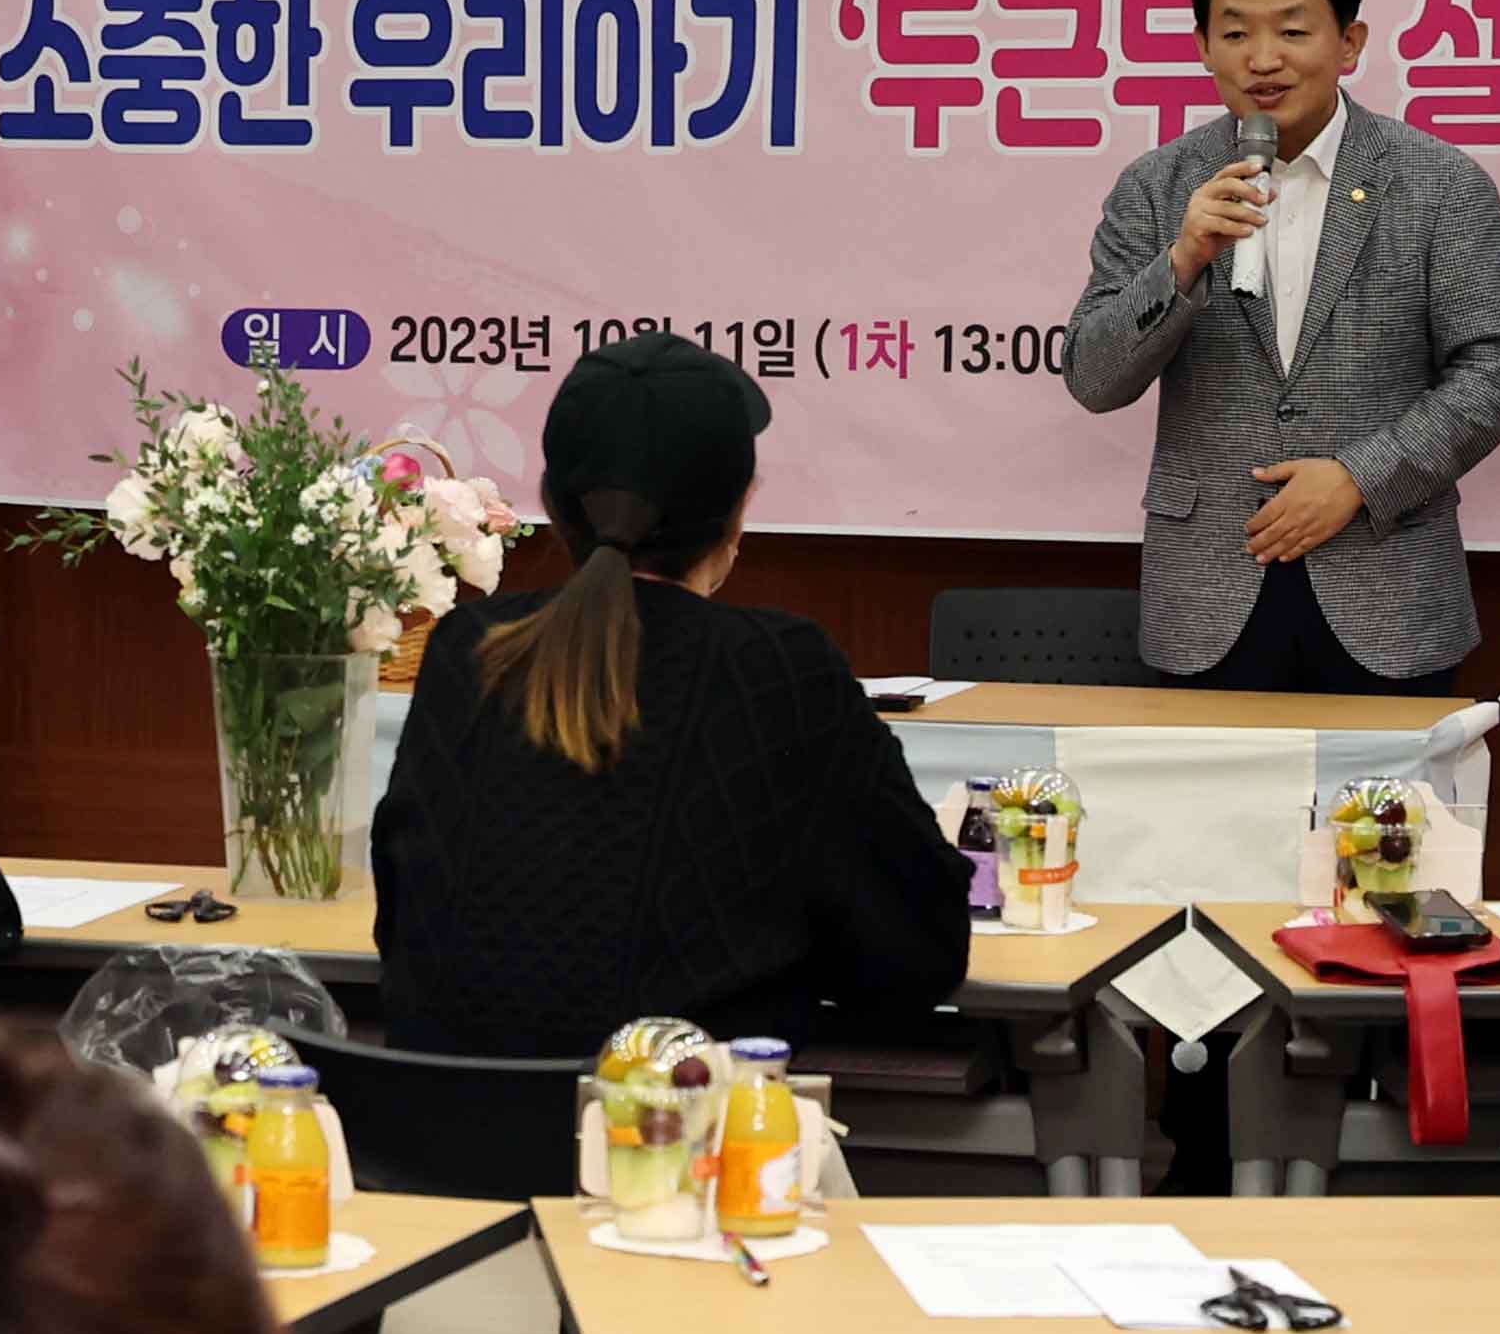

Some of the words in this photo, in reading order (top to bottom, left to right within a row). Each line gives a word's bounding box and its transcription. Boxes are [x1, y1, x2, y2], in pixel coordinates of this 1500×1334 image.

[390, 315, 551, 372] 2023년
[694, 318, 796, 378] 11일
[815, 318, 915, 379] (1차
